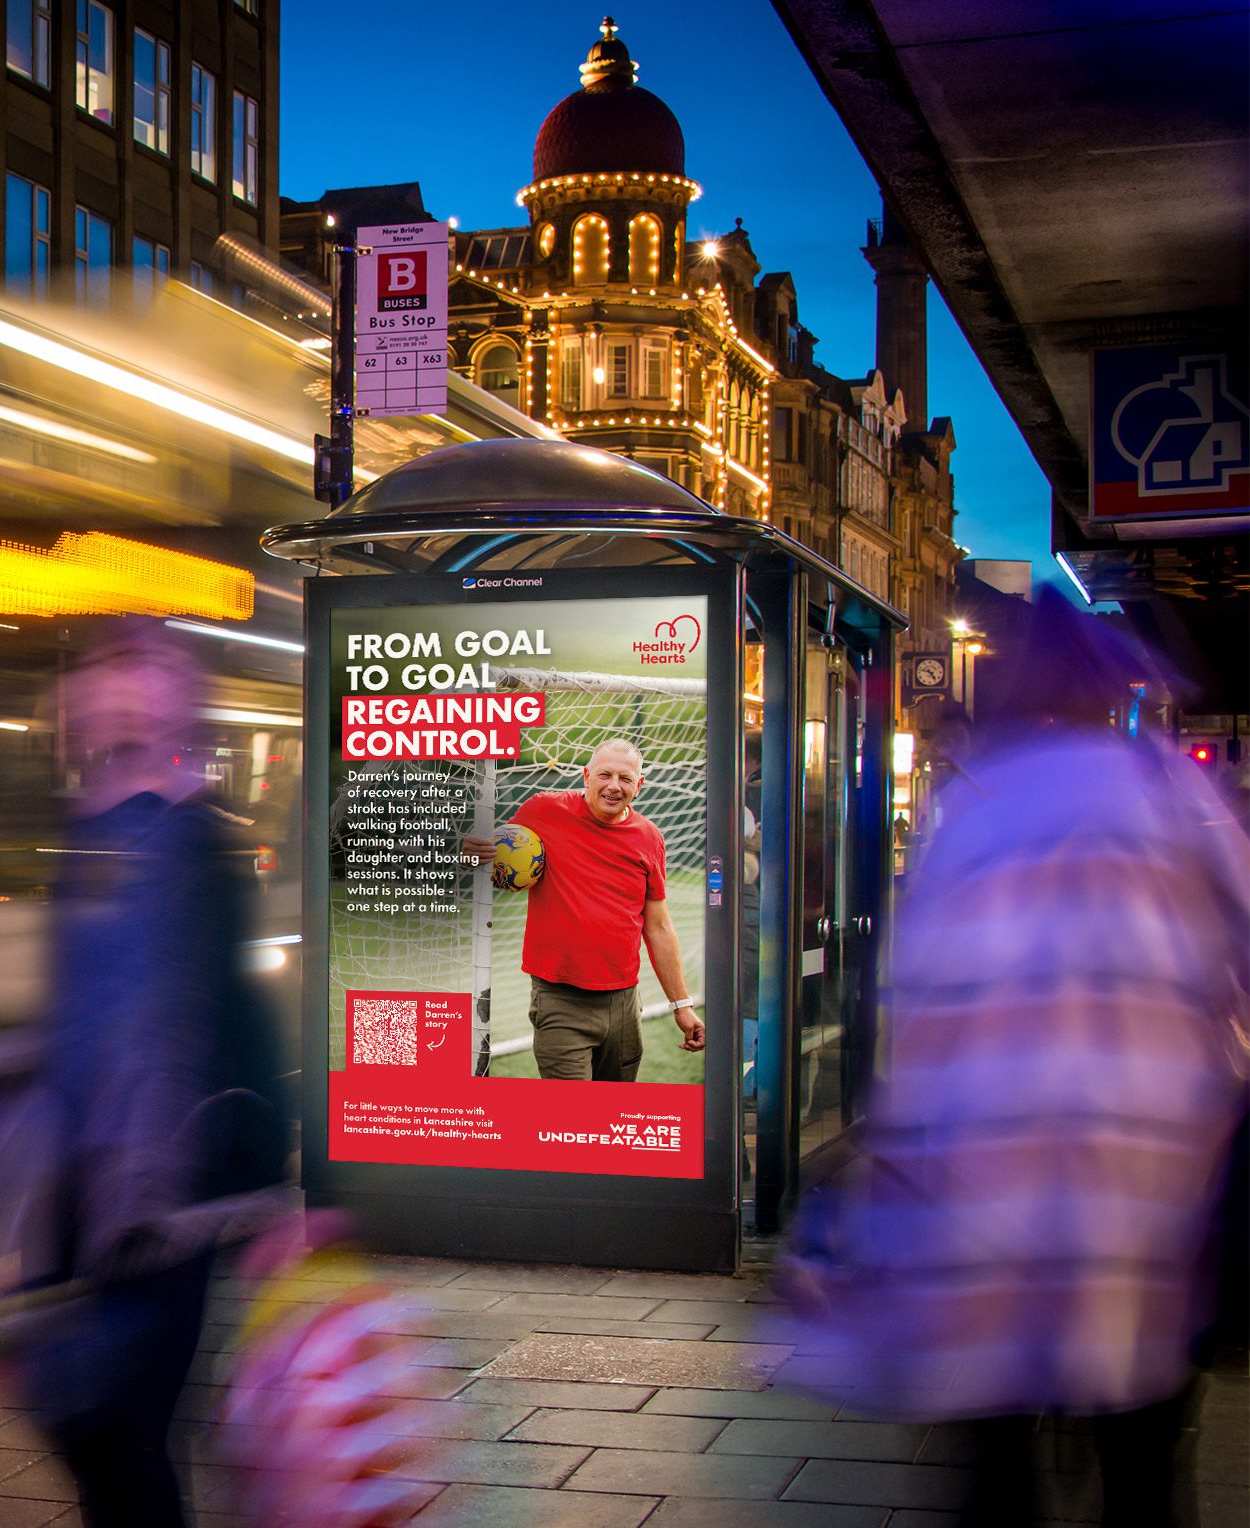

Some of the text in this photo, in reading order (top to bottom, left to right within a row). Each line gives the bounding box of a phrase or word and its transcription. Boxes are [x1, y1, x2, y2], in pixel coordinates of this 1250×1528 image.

[388, 258, 416, 291] B
[384, 298, 420, 309] BUSES
[370, 315, 436, 328] Bus Stop
[365, 355, 441, 367] 62 63 X63
[477, 577, 542, 588] Clear Channel
[347, 629, 551, 660] FROM GOAL
[632, 641, 685, 654] Healthy
[640, 653, 685, 664] Hearts
[346, 662, 496, 691] TO GOAL
[347, 696, 540, 725] REGAINING
[346, 727, 515, 757] CONTROL.
[348, 770, 450, 784] Darren's journey
[348, 785, 463, 800] of recovery after a
[348, 802, 466, 814] stroke has included
[348, 818, 451, 833] walking football,
[348, 835, 445, 849] running with his
[347, 851, 480, 866] daughter and boxing
[347, 868, 454, 880] sessions. It shows
[347, 884, 378, 895] what
[382, 885, 390, 895] is
[394, 884, 445, 898] possible
[347, 901, 460, 915] one step at a time.
[425, 1001, 448, 1009] Read
[425, 1021, 448, 1030] story
[344, 1102, 358, 1110] For
[360, 1102, 378, 1111] little
[379, 1105, 402, 1114] ways
[441, 1107, 463, 1115] more
[466, 1106, 485, 1116] with
[344, 1114, 494, 1128] heart conditions in Lancashire visit
[620, 1113, 645, 1121] Proudly
[344, 1125, 502, 1140] lancashire.gov.uk/healthy-hearts
[610, 1124, 681, 1136] WE ARE
[538, 1131, 681, 1148] UNDEFEATABLE
